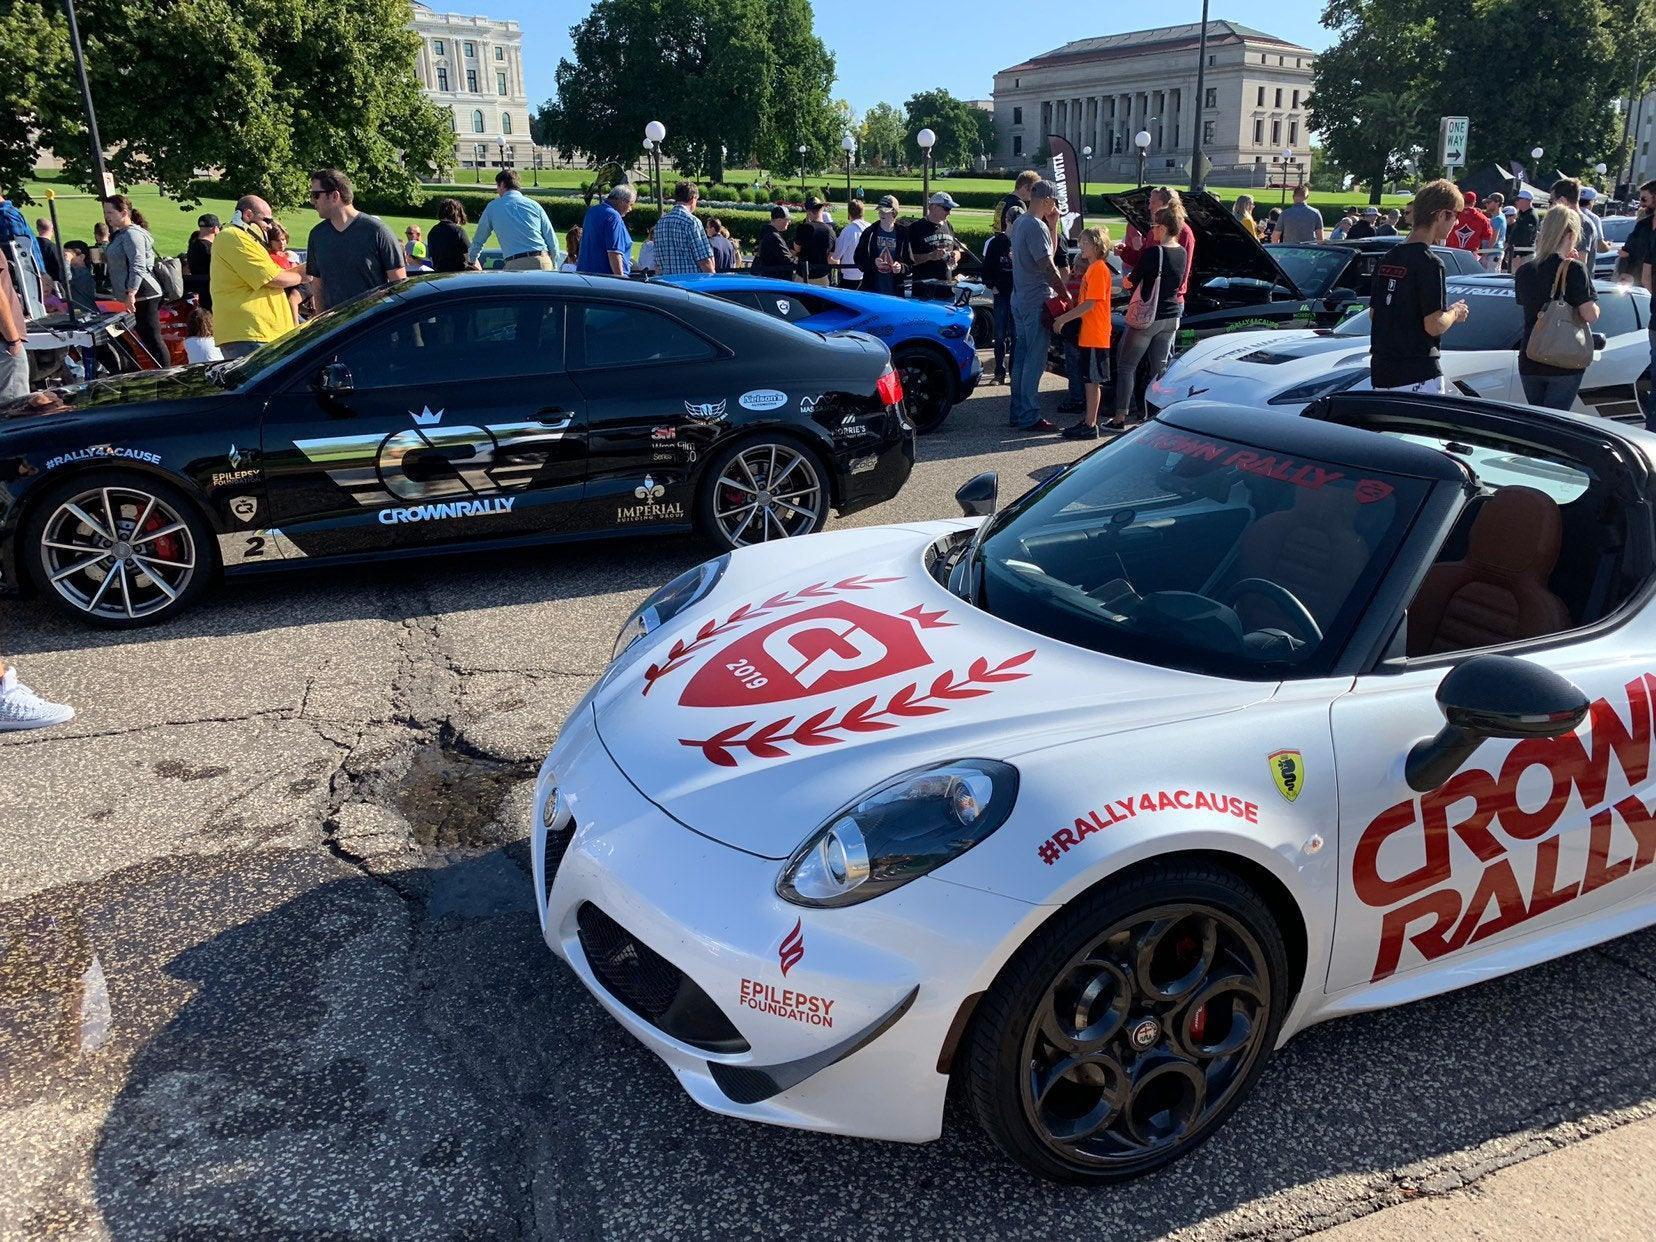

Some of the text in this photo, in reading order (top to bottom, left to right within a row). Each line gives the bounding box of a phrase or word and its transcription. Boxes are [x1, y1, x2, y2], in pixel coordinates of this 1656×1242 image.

[1448, 121, 1466, 133] ONE
[1448, 135, 1465, 147] WAY
[45, 445, 162, 470] #RALLY4ACAUSE
[1222, 451, 1344, 491] RALLY
[211, 468, 260, 482] EPILEPSY
[617, 502, 684, 518] IMPERIAL
[244, 536, 266, 558] 2
[725, 657, 769, 690] 2019
[1352, 671, 1656, 908] CROW
[1037, 789, 1260, 867] #RALLY4ACAUSE
[740, 977, 835, 1016] EPILEPSY
[740, 994, 834, 1028] FOUNDATION
